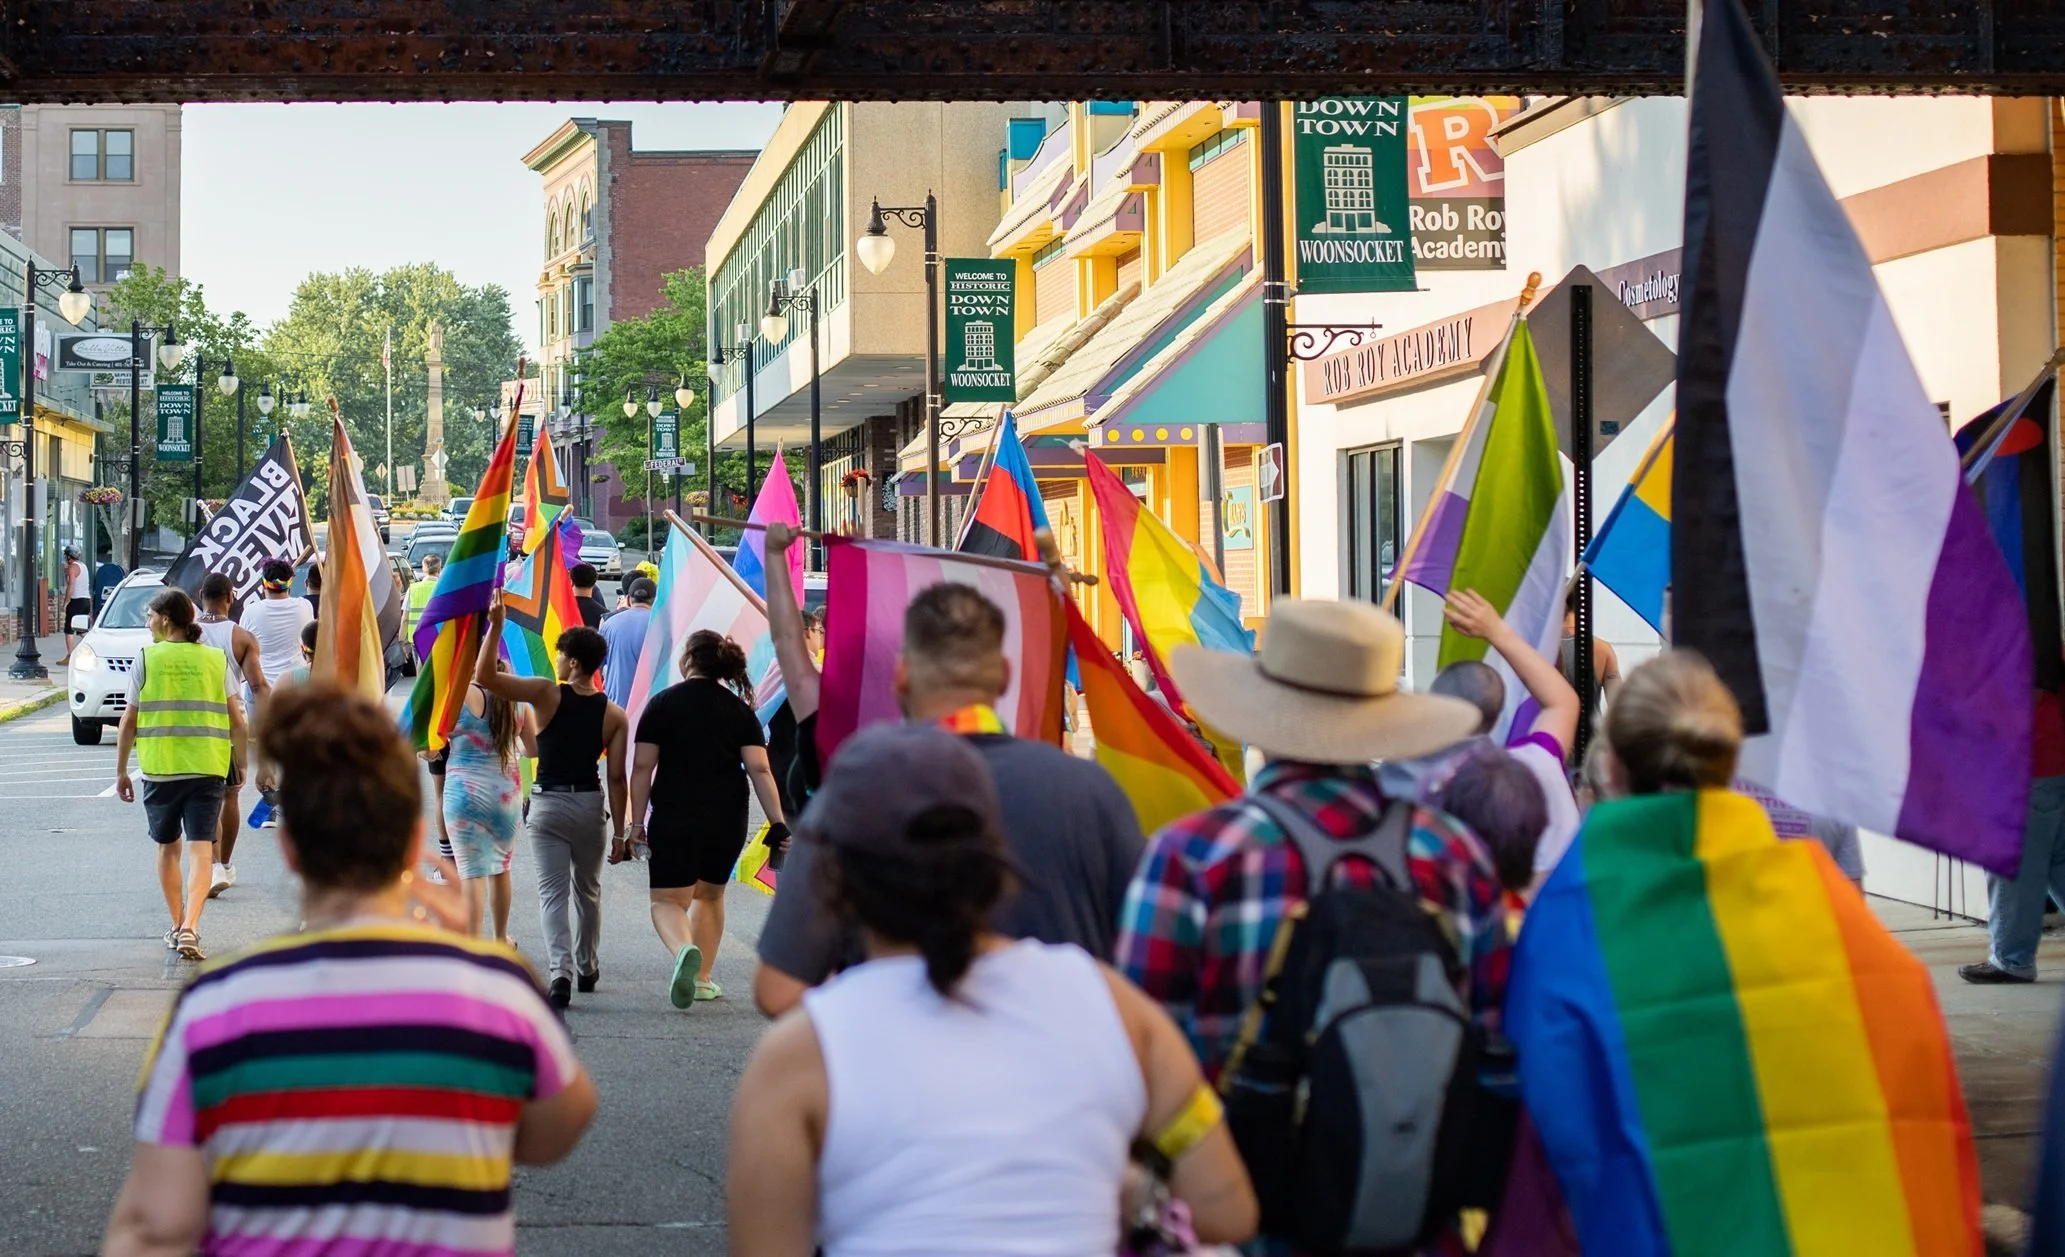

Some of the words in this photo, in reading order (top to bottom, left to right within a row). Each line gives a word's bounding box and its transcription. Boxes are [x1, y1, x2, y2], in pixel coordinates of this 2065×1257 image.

[1298, 100, 1400, 117] DOWN
[1297, 119, 1400, 136] TOWN
[1410, 203, 1459, 231] Rob
[1300, 240, 1404, 263] WOONSOCKET
[955, 272, 994, 280] WELCOME
[1618, 270, 1680, 307] Cosmetology
[951, 295, 1010, 304] DOWN
[950, 306, 1010, 315] TOWN
[1323, 355, 1351, 395] ROB
[1357, 343, 1385, 387] ROY
[1392, 316, 1473, 377] ACADEMY
[950, 373, 1011, 387] WOONSOCKET
[158, 444, 191, 452] WOONSOCKET
[650, 459, 680, 469] FEDERAL
